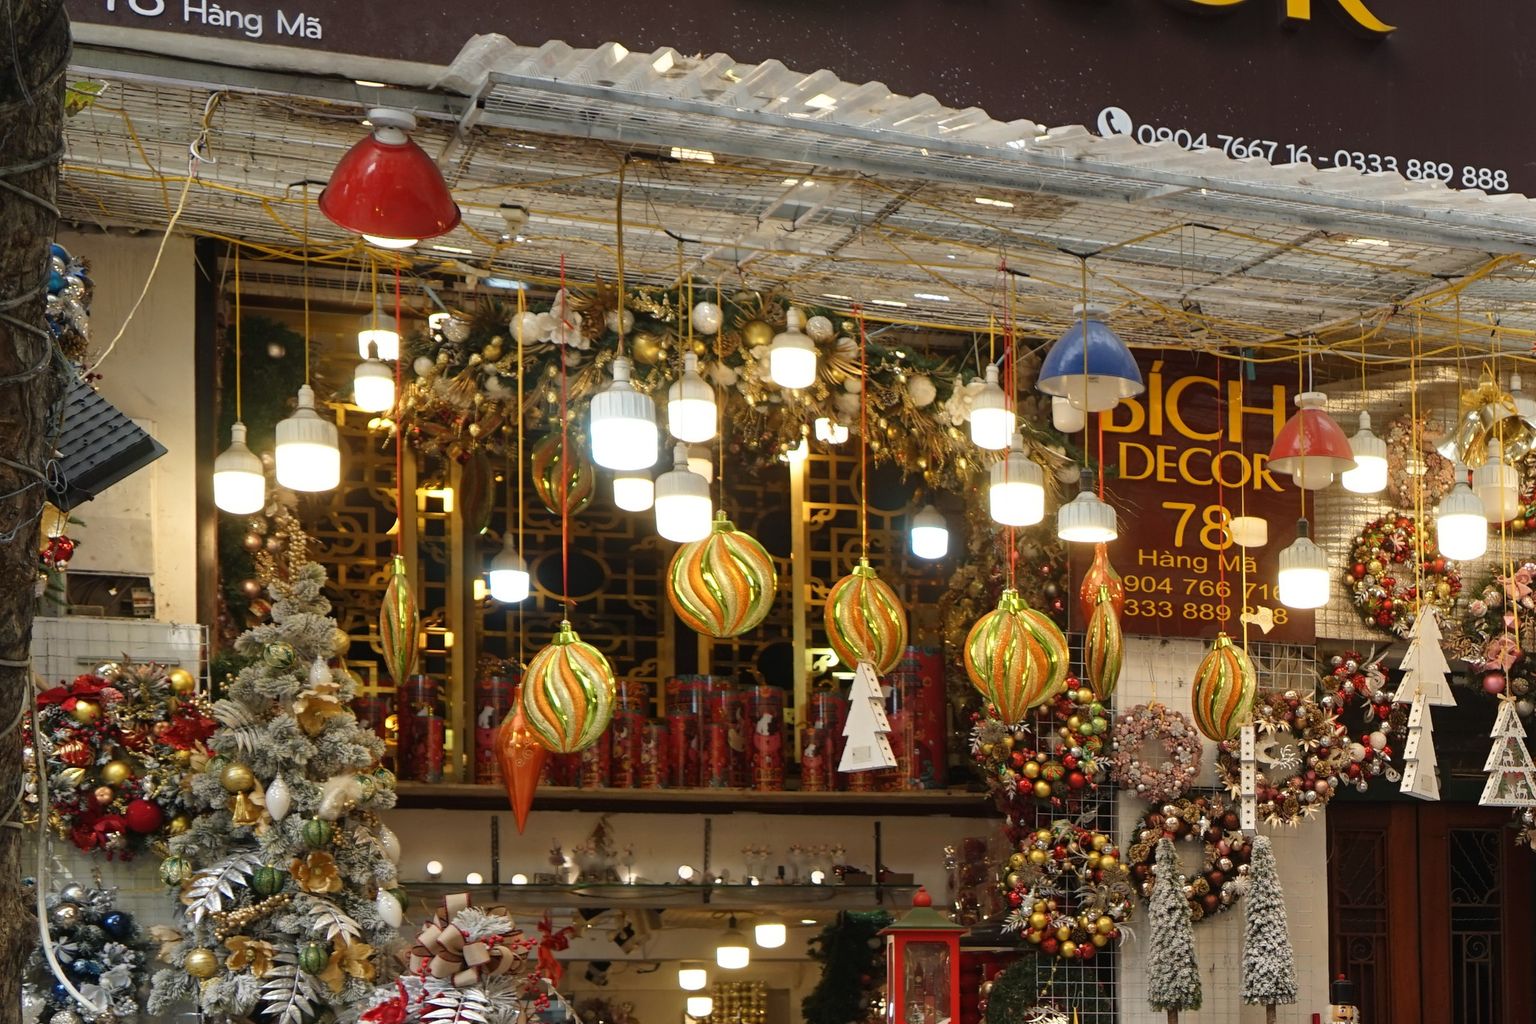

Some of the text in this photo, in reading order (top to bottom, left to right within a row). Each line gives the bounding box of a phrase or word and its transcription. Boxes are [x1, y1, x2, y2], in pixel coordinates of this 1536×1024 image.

[183, 0, 263, 38] Hàng
[277, 10, 322, 40] Mã
[1137, 124, 1210, 154] 0904
[1217, 134, 1278, 163] 7667
[1286, 144, 1312, 165] 16
[1334, 150, 1398, 175] 0333
[1406, 159, 1454, 184] 889
[1462, 166, 1509, 191] 888
[1118, 441, 1287, 493] DECOR
[1162, 501, 1235, 552] 78
[1137, 549, 1257, 574] Hàng Mã
[1123, 575, 1174, 595] 904
[1183, 578, 1232, 599] 766
[1123, 599, 1174, 618] 333
[1183, 602, 1232, 621] 889
